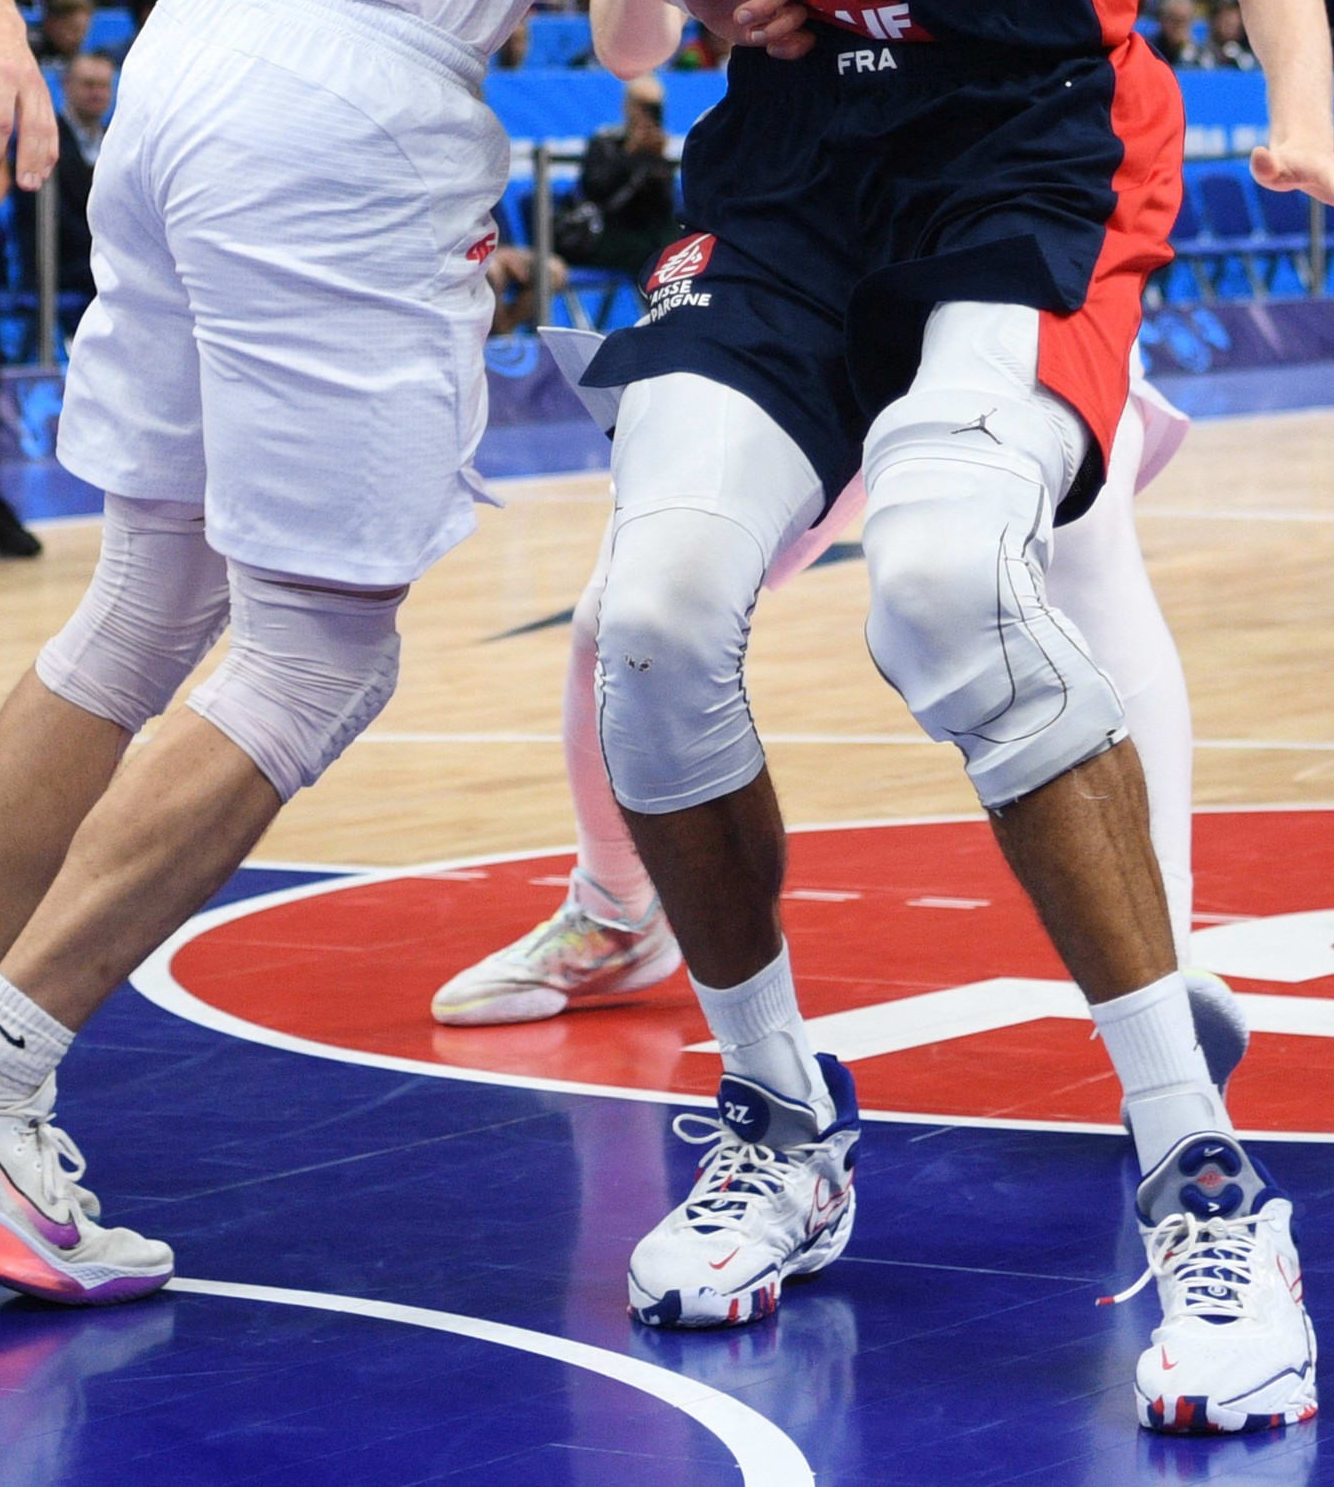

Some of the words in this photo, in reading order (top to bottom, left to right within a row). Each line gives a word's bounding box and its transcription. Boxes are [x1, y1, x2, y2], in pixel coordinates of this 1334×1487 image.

[837, 47, 898, 75] FRA
[649, 279, 693, 307] AISSE
[650, 293, 713, 323] PARGNE
[724, 1100, 750, 1123] 27
